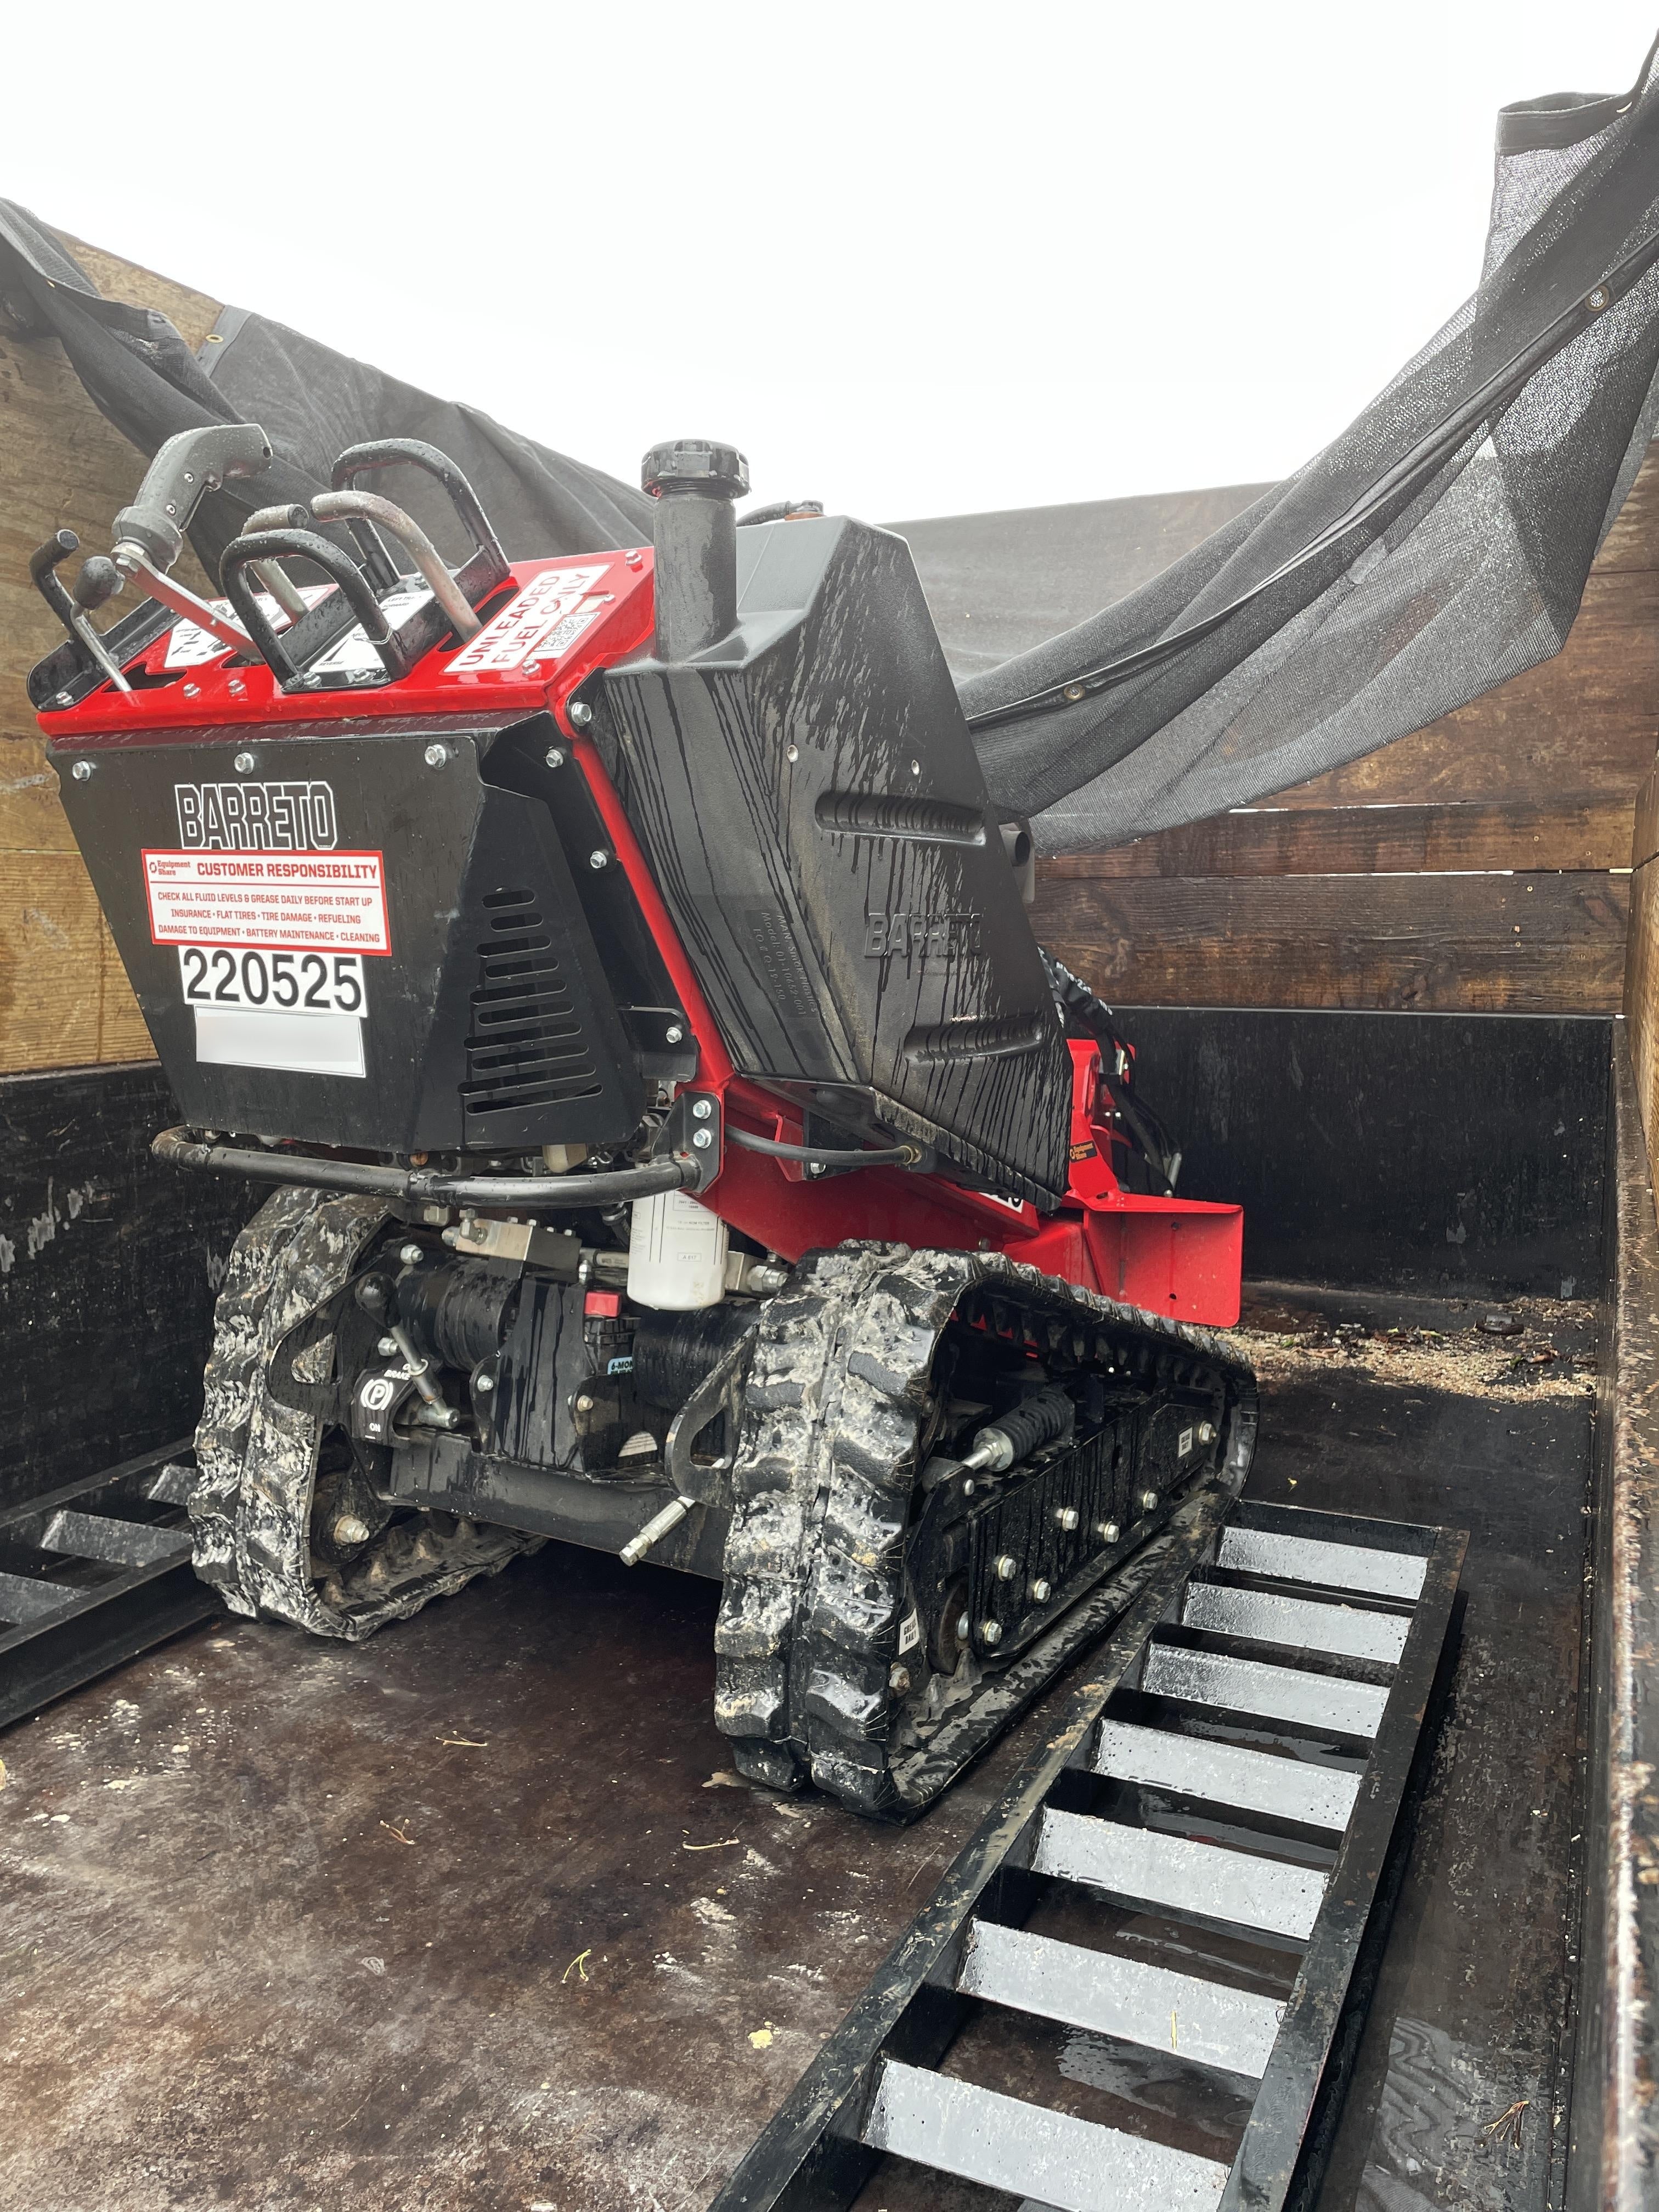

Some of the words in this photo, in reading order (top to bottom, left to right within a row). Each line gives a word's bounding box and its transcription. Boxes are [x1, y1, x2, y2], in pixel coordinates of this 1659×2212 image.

[459, 575, 560, 666] UNLEADED
[492, 619, 548, 663] FUEL
[540, 574, 590, 614] ONLY
[174, 781, 338, 850] BARRETO
[157, 860, 191, 868] Equipment
[197, 862, 264, 877] CUSTOMER
[267, 864, 377, 879] RESPONSIBILITY
[157, 892, 180, 901] CHECK
[182, 893, 194, 901] ALL
[195, 893, 216, 902] FLUID
[217, 893, 242, 902] LEVELS
[244, 894, 250, 903] &
[251, 894, 280, 904] GREASE
[281, 895, 302, 905] DAILY
[304, 896, 334, 905] BEFORE
[335, 897, 359, 906] START
[362, 898, 373, 906] UP
[171, 909, 212, 918] INSURANCE
[217, 910, 233, 919] FLAT
[234, 911, 256, 920] TIRES
[261, 912, 279, 921] TIRE
[280, 912, 313, 922] DAMAGE
[318, 914, 361, 924] REFUELING
[159, 924, 188, 934] DAMAGE
[188, 926, 198, 934] TO
[199, 926, 240, 936] EQUIPMENT
[246, 928, 278, 938] BATTERY
[280, 930, 335, 940] MAINTENANCE
[340, 933, 380, 943] CLEANING
[761, 912, 781, 948] Model:
[864, 913, 983, 958] BARRETO
[183, 948, 362, 1012] 220525
[383, 1369, 411, 1380] BRAKE
[611, 1361, 633, 1370] 6-MON
[369, 1423, 381, 1432] ON
